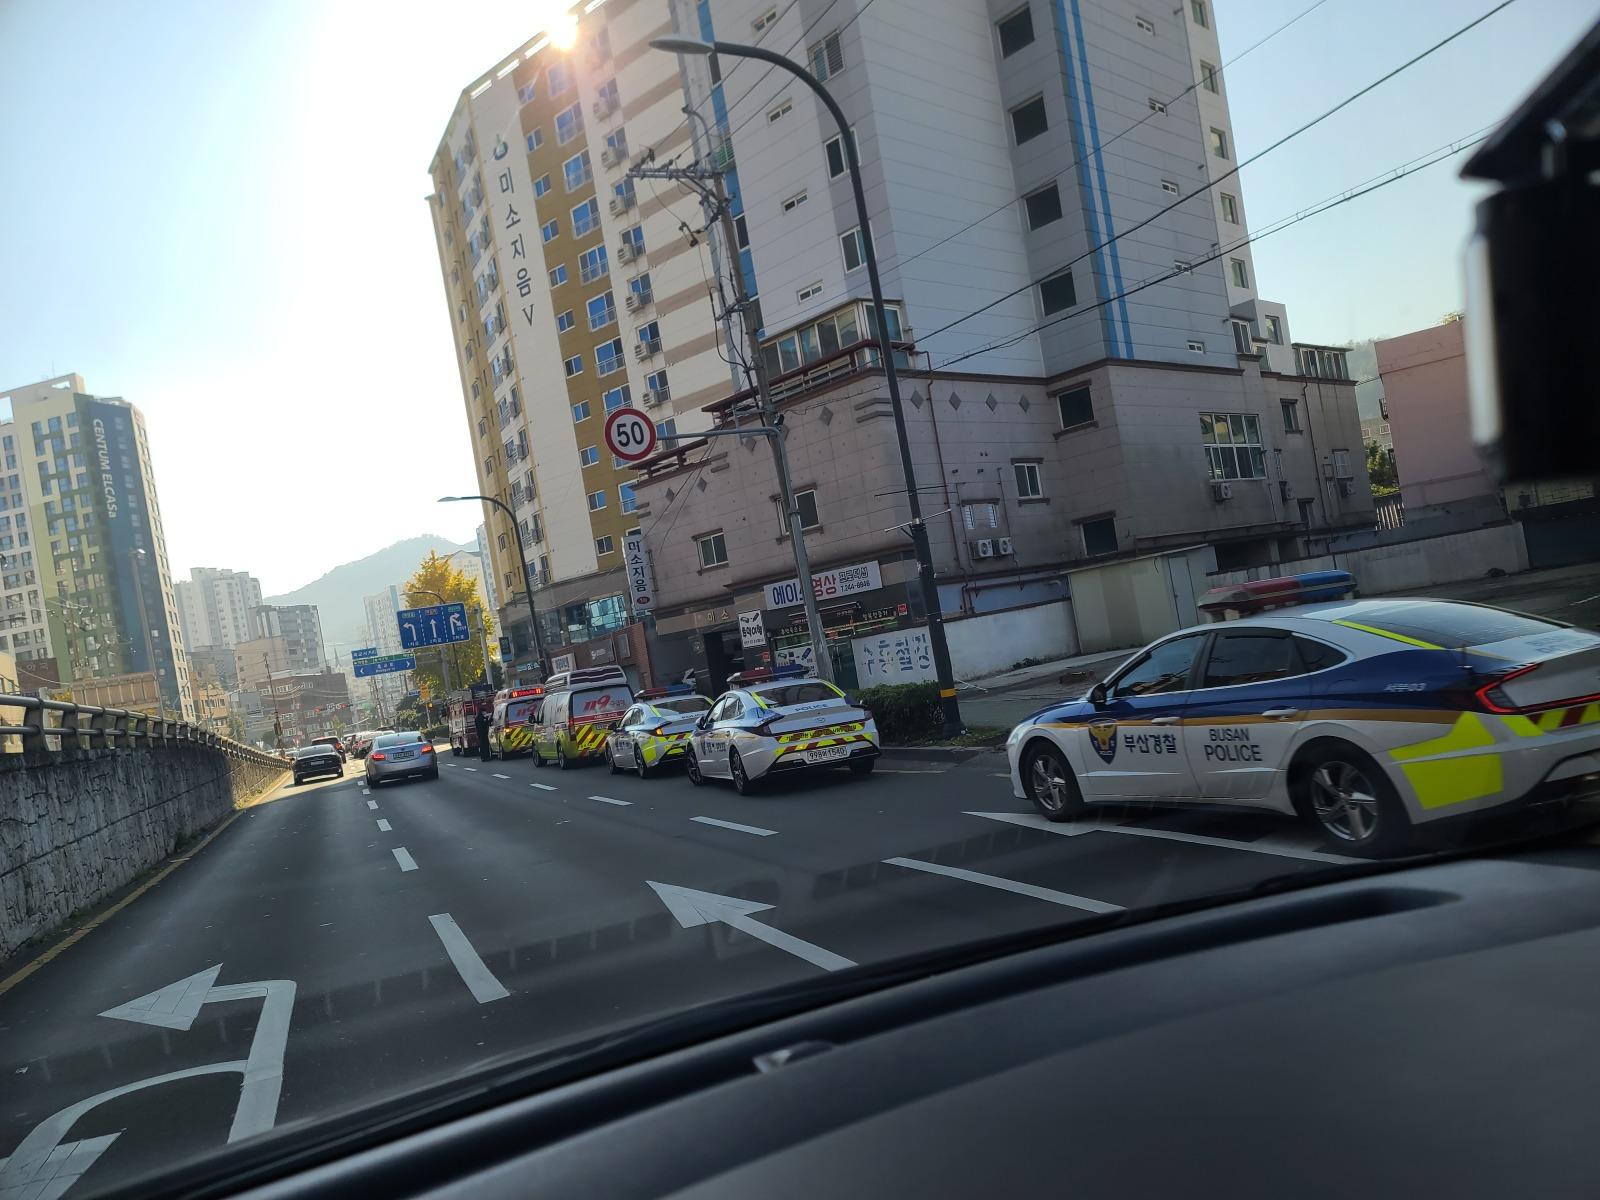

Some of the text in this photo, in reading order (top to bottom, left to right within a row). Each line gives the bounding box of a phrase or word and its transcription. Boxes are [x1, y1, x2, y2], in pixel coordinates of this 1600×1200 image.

[500, 167, 534, 327] 미소지음 V
[93, 418, 111, 470] CENTUM
[616, 421, 644, 447] 50
[628, 540, 647, 592] 미소지음
[811, 574, 837, 597] 영상
[584, 694, 611, 711] 119
[795, 703, 828, 712] POLICE
[1124, 734, 1177, 754] 부산경찰
[1209, 728, 1250, 742] BUSAN
[1204, 744, 1263, 762] POLICE
